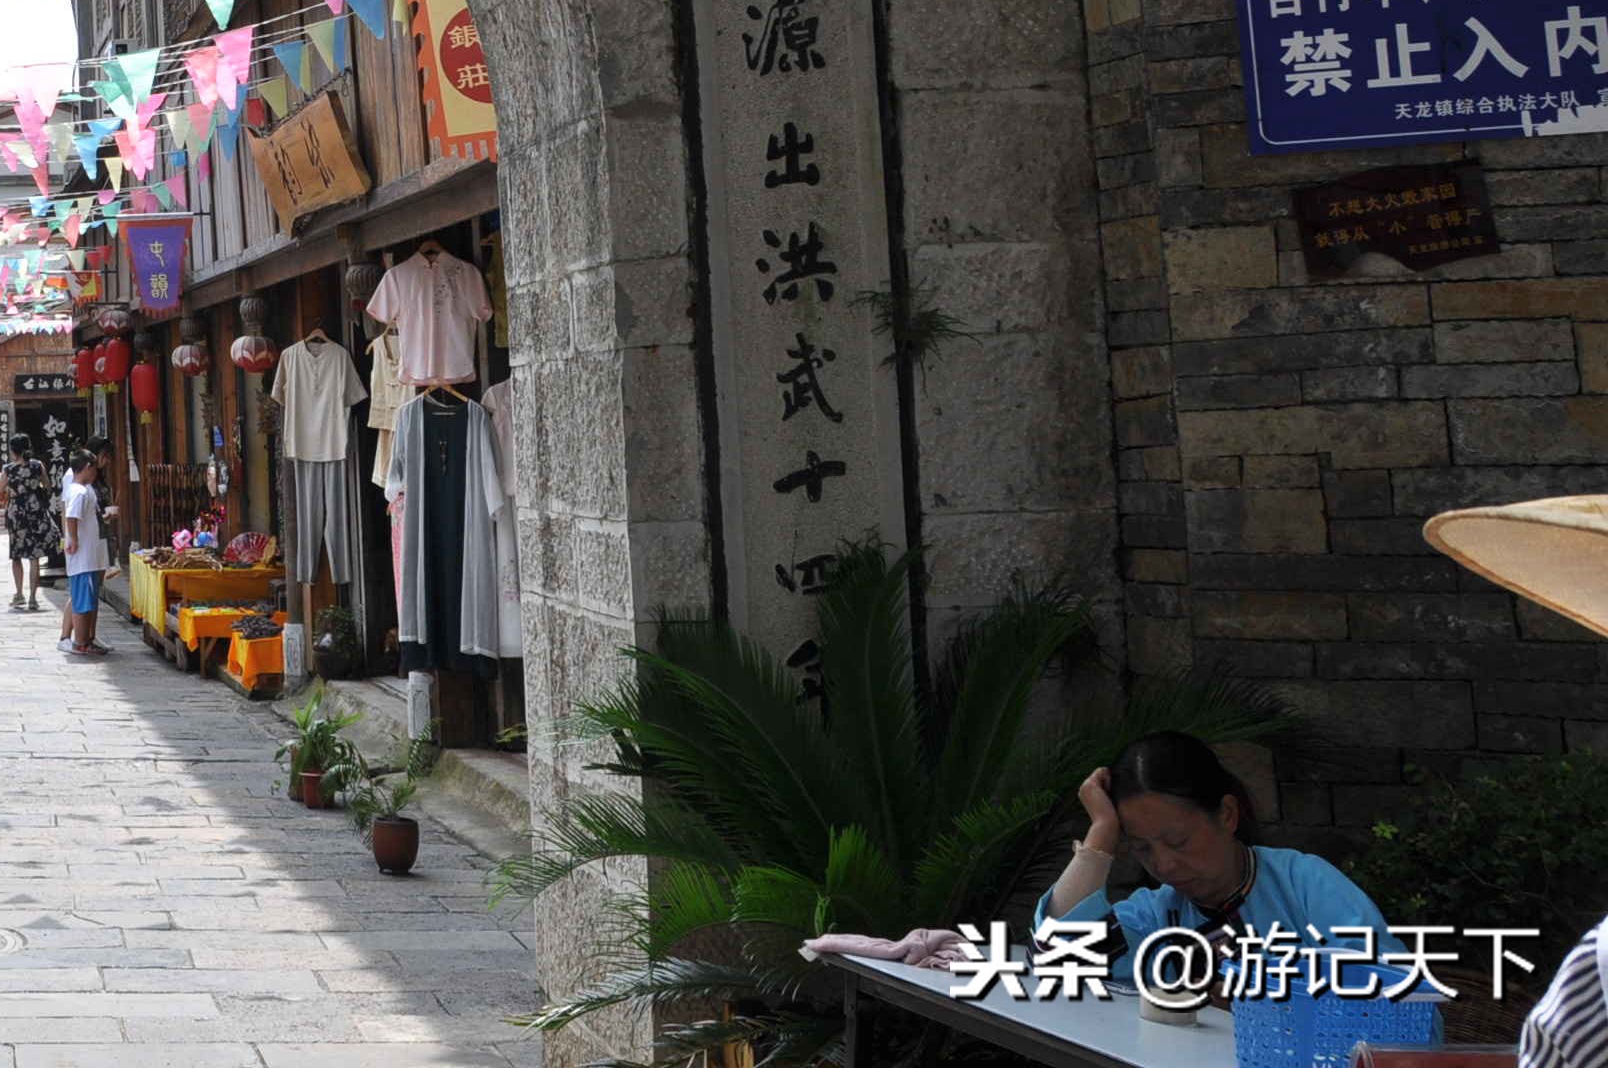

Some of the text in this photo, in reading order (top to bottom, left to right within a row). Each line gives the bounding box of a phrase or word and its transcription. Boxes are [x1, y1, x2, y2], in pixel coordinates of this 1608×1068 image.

[1279, 6, 1608, 98] 禁止入内
[1394, 89, 1580, 121] 天龙镇综合执法大队
